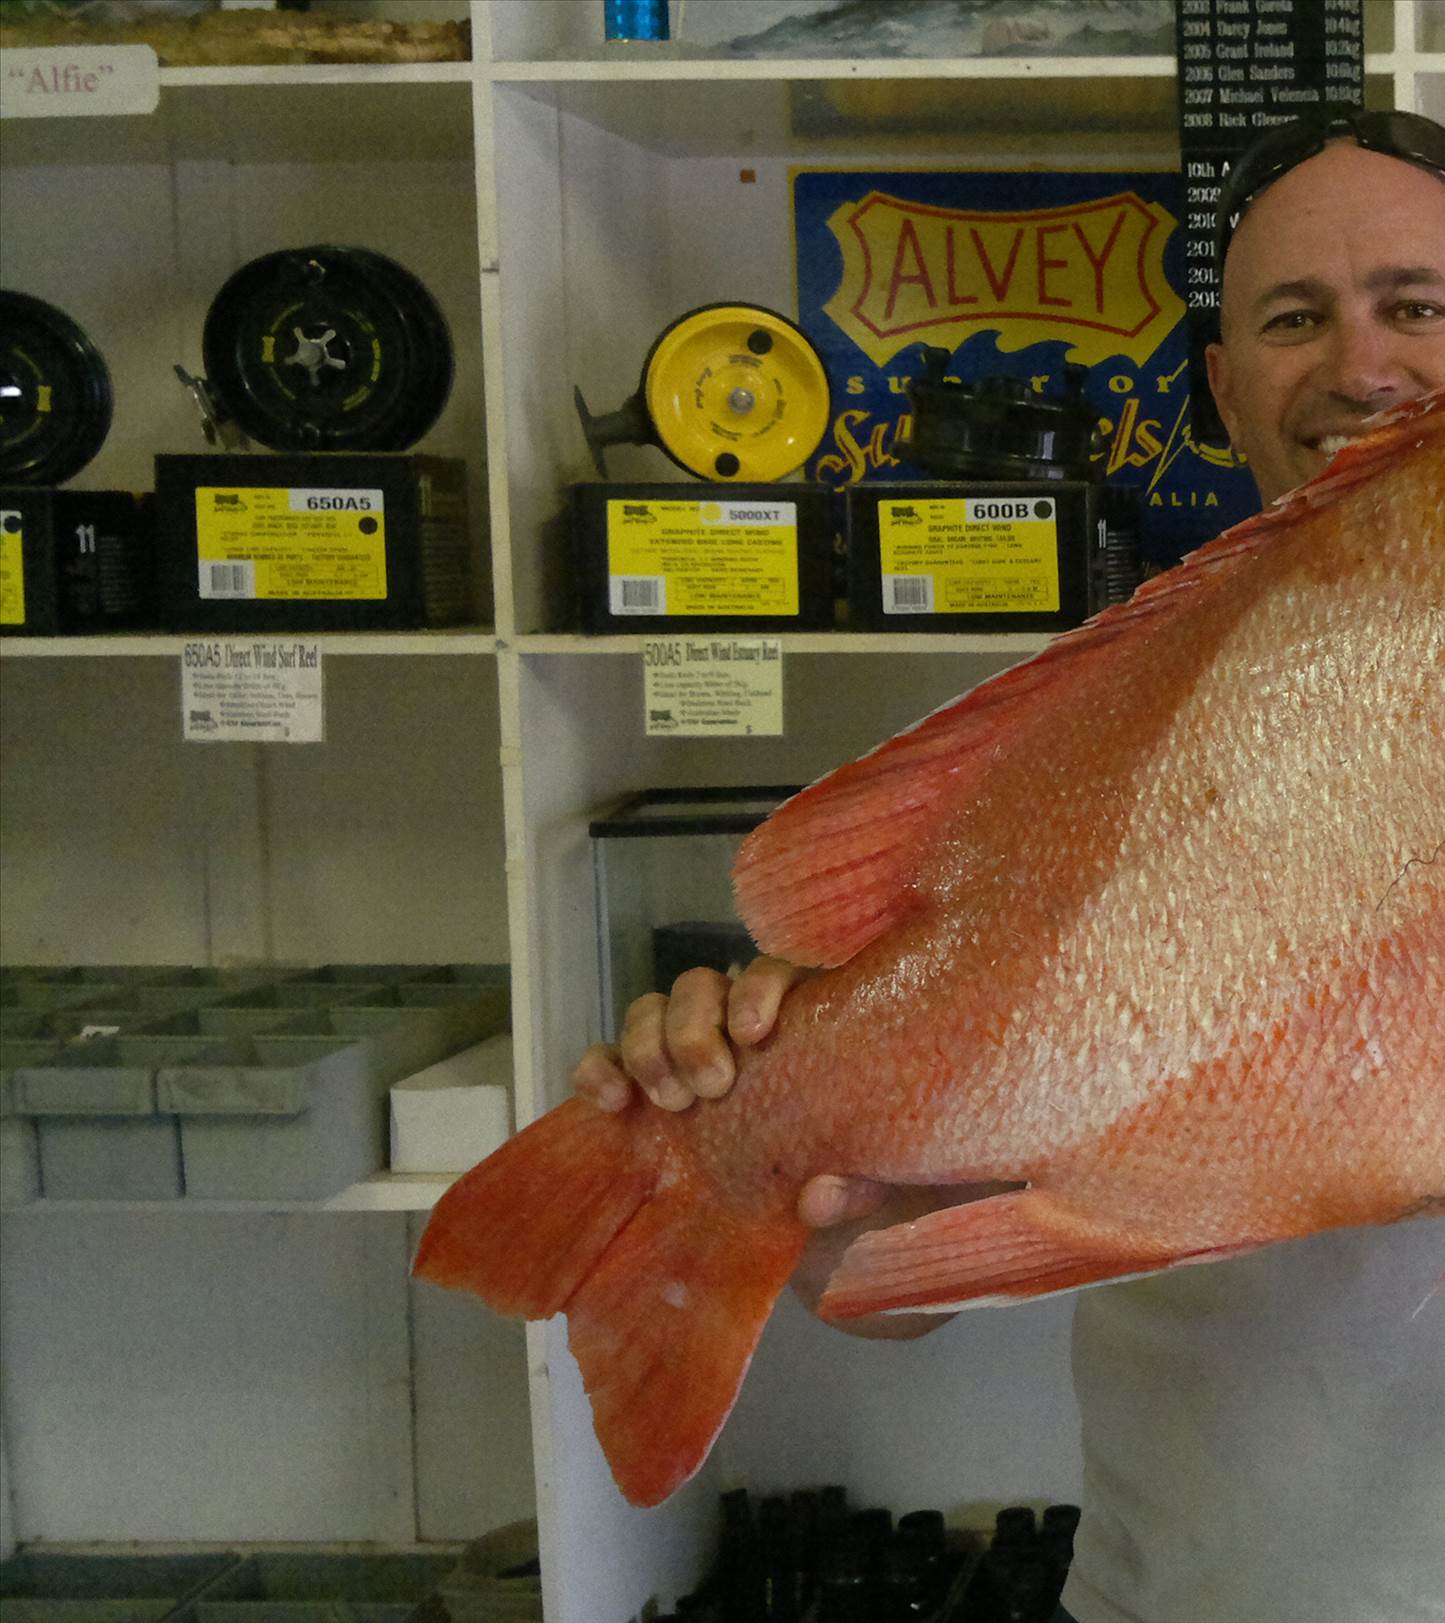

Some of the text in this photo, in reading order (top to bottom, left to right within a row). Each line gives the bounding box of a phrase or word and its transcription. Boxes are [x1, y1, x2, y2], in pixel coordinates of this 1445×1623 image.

[1183, 21, 1210, 37] 2004
[1217, 21, 1250, 39] Darcy
[1184, 44, 1211, 60] 2005
[1216, 43, 1248, 58] Grant
[1254, 41, 1294, 58] Ireland
[1185, 66, 1213, 82] 2006
[1218, 65, 1244, 81] Glen
[1249, 65, 1295, 80] Sanders
[1185, 88, 1213, 104] 2007
[1219, 87, 1264, 103] Michael
[1219, 112, 1247, 127] Rick
[1187, 163, 1215, 178] 10th
[1187, 240, 1215, 256] 201
[884, 211, 1128, 321] ALVEY
[1188, 267, 1219, 283] 201
[307, 496, 371, 511] 650A5
[973, 504, 1028, 519] 600B
[729, 510, 780, 521] 5000XT
[965, 524, 990, 532] DIRECT
[76, 524, 96, 553] 11
[185, 644, 318, 668] 650A5 Direct Wind Surf Reel
[686, 642, 709, 661] Direct
[711, 642, 731, 661] Wind
